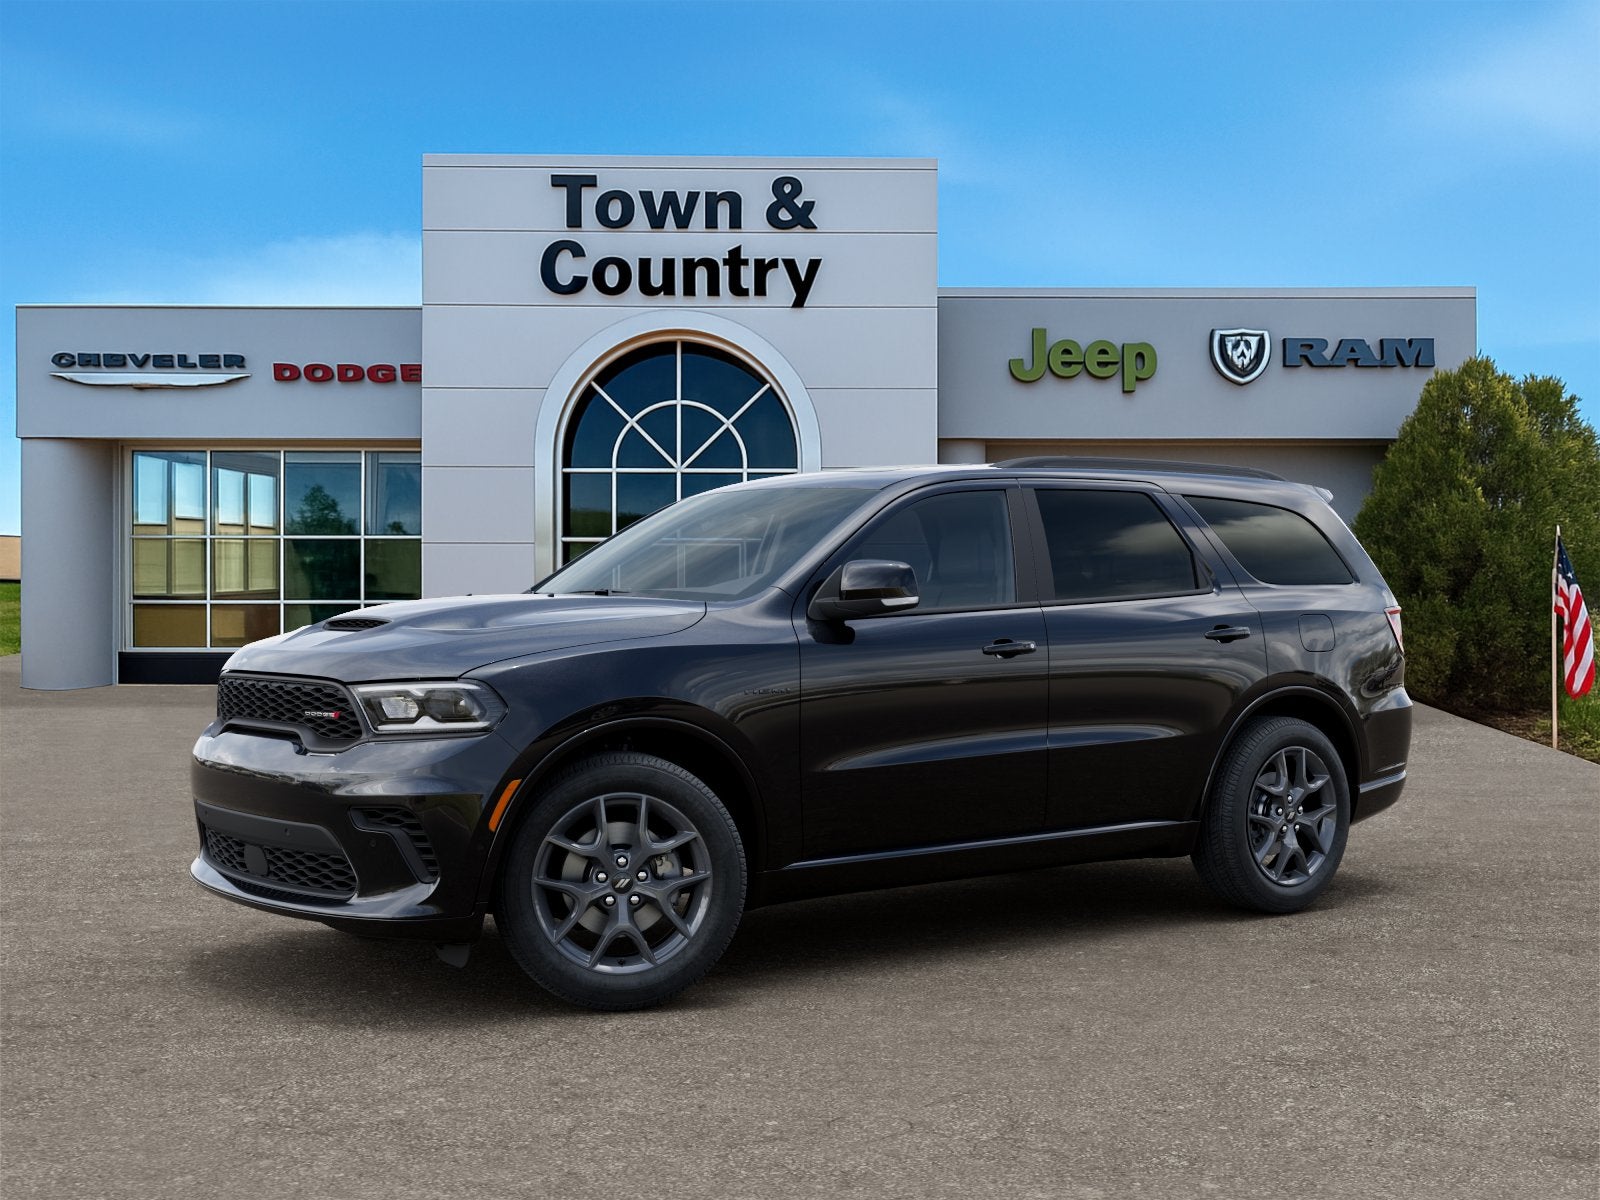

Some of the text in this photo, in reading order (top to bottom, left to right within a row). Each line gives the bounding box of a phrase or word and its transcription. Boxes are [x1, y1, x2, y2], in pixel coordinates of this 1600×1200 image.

[550, 174, 819, 230] Town &
[539, 239, 822, 308] Country
[272, 363, 422, 383] DODGE
[1008, 328, 1158, 393] Jeep
[1282, 337, 1436, 368] RAM
